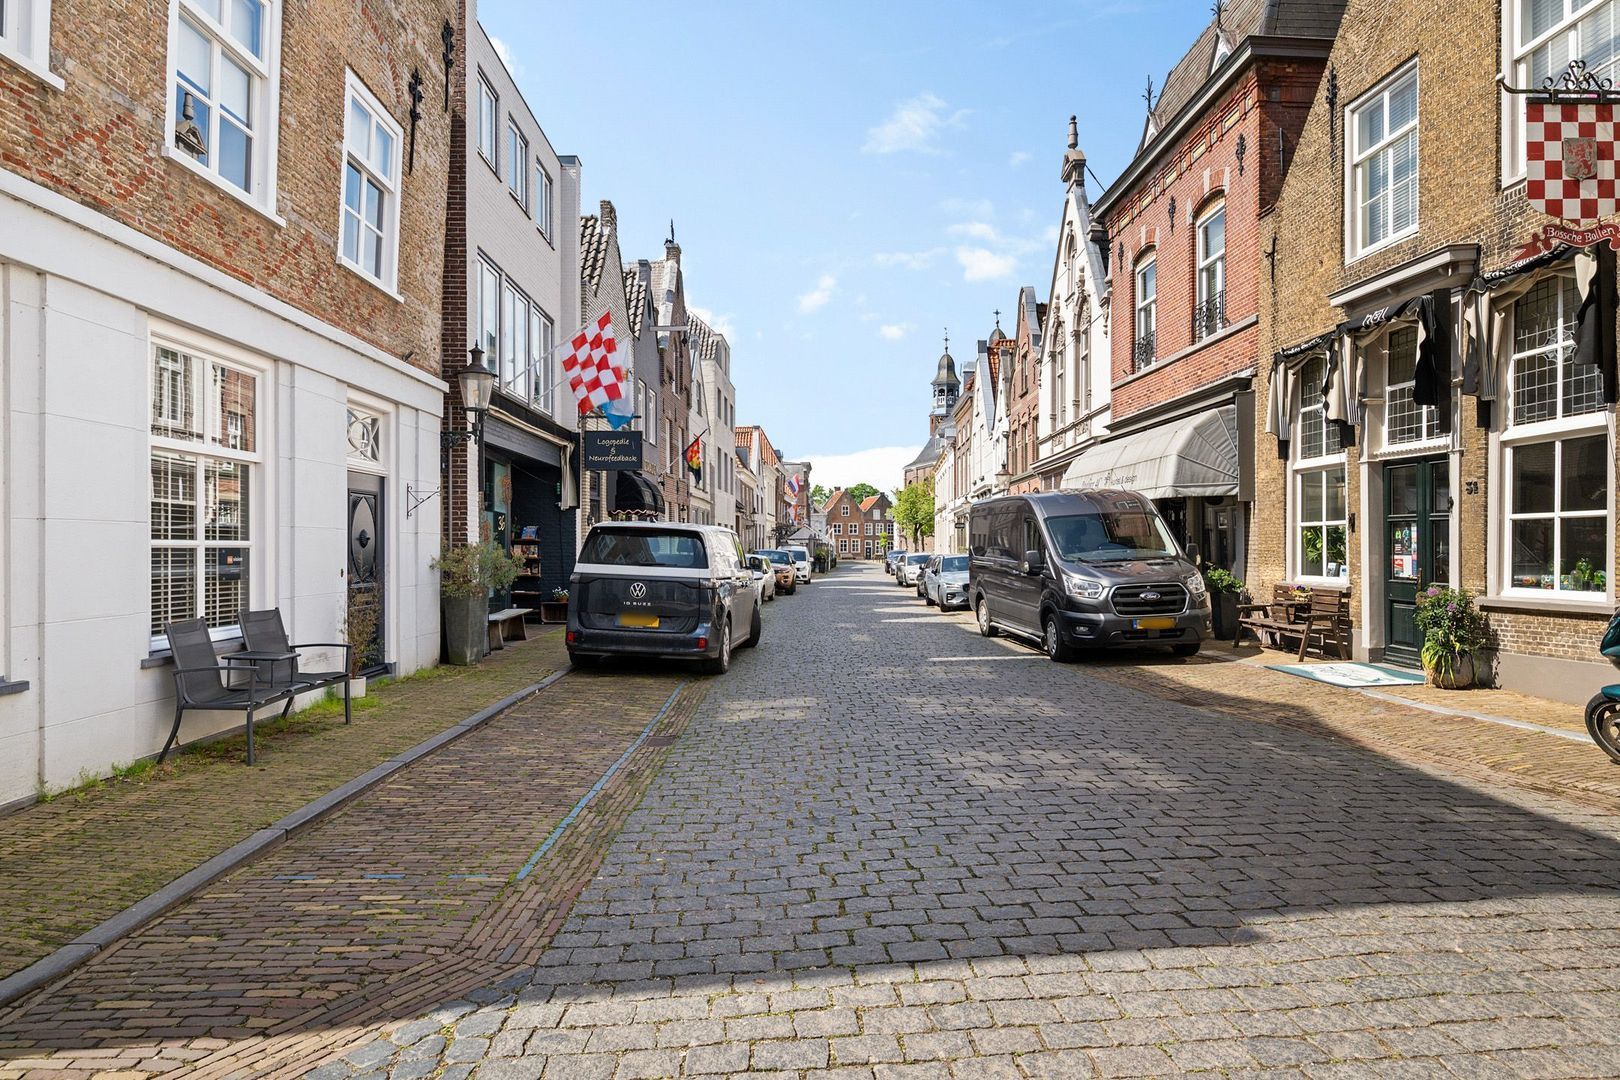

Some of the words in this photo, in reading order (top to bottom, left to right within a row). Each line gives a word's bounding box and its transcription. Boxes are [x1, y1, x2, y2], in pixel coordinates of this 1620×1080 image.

[1547, 227, 1582, 242] Bossche
[1584, 227, 1615, 242] Bollen
[597, 438, 630, 447] Logopedie
[588, 455, 638, 463] Neurofeedback
[498, 515, 506, 531] 36
